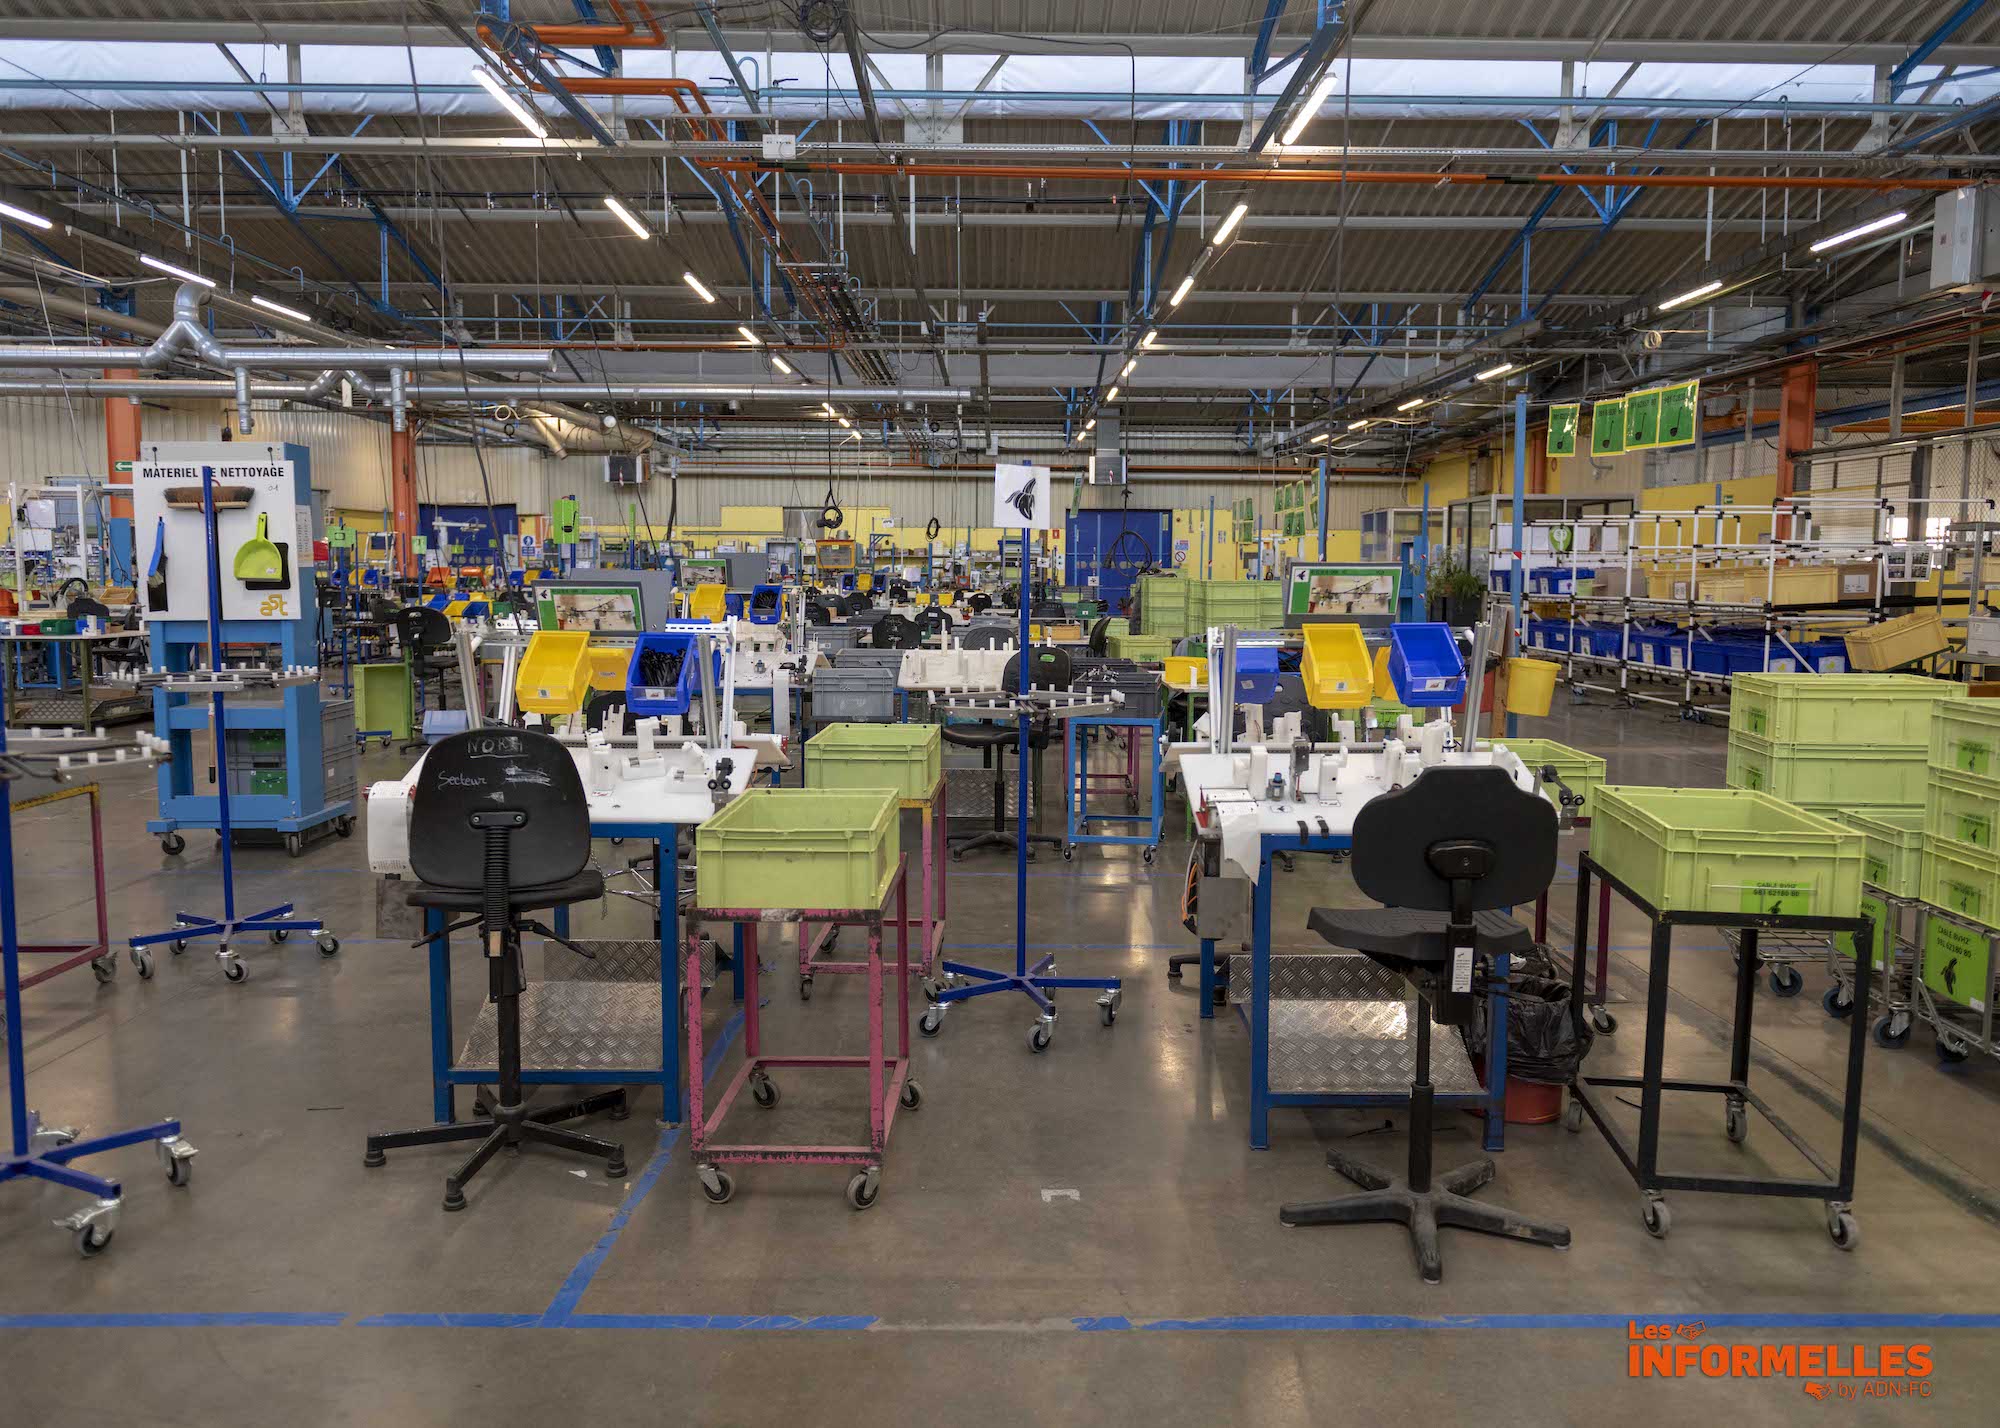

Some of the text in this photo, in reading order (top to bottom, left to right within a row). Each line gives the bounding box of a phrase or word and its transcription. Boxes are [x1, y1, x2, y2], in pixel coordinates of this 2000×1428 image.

[143, 468, 198, 478] MATERIEL
[220, 467, 284, 477] NETTOYAGE
[438, 770, 488, 792] Secteur
